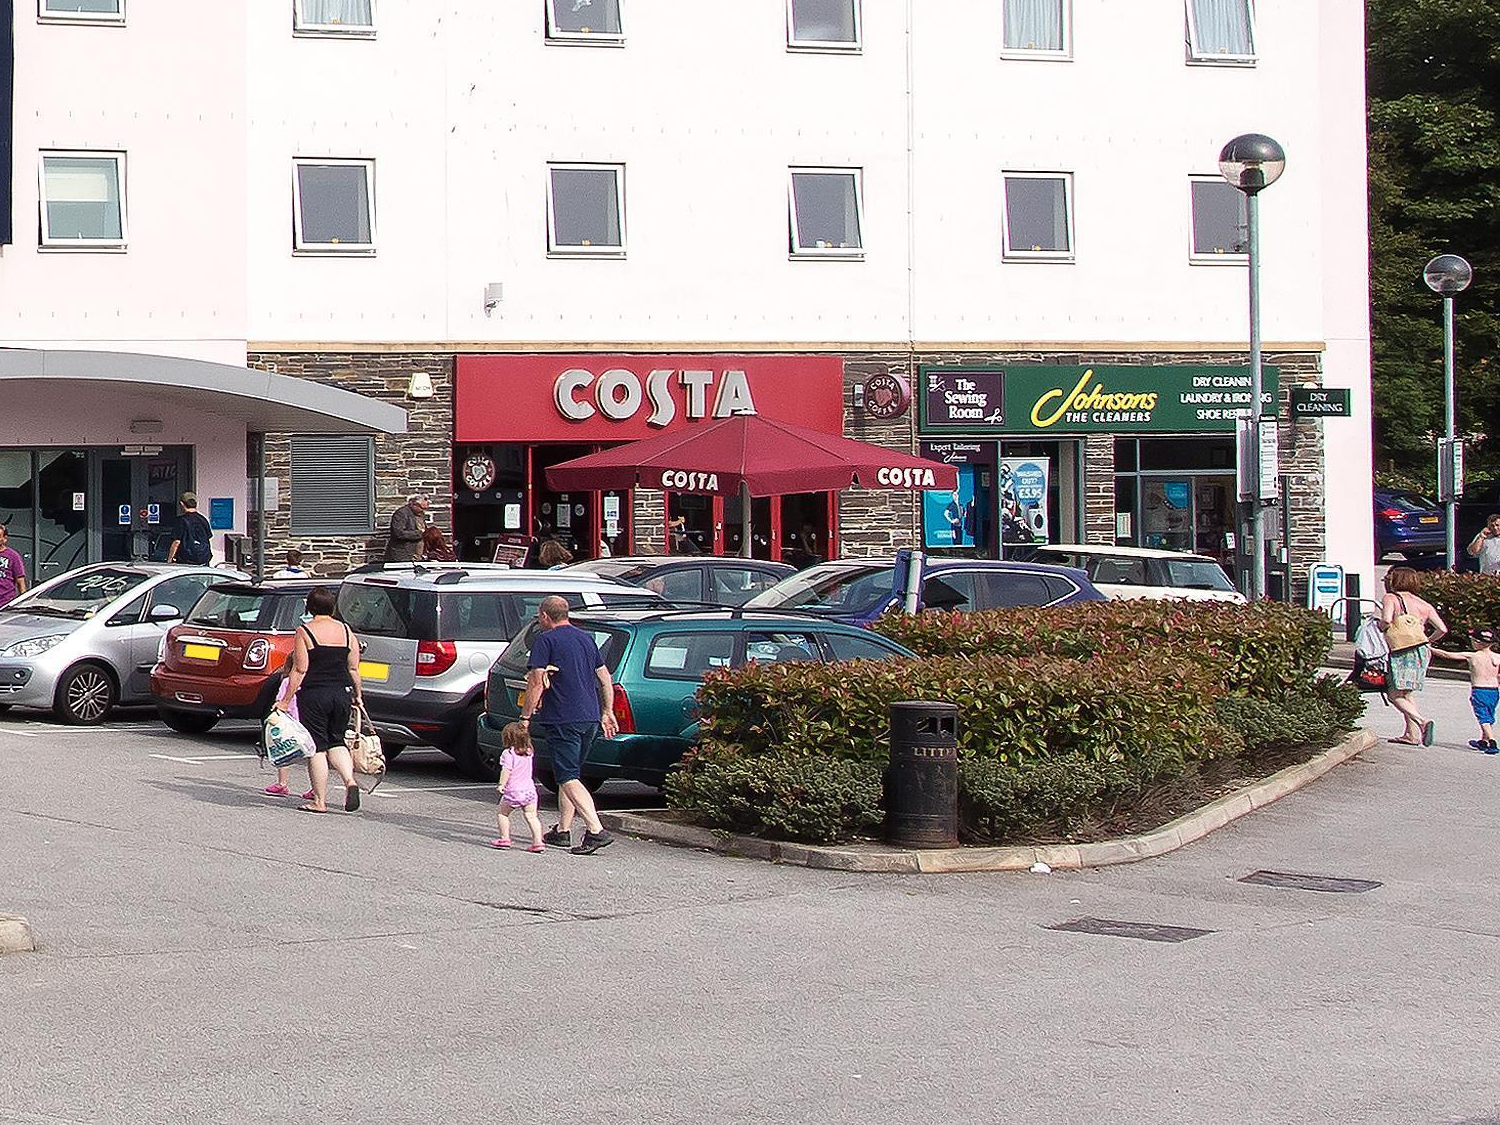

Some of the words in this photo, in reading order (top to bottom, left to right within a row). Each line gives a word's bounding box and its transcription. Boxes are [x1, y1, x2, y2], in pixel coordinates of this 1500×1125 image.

[955, 378, 976, 391] The
[1192, 376, 1211, 387] DRY
[1211, 376, 1252, 387] CLEANIN
[553, 368, 757, 426] COSTA
[944, 390, 988, 407] Sewing
[1030, 368, 1158, 428] Johnsons
[1180, 393, 1223, 403] LAUNDRY
[1223, 393, 1232, 403] &
[1309, 392, 1328, 402] DRY
[948, 405, 984, 419] Room
[1296, 403, 1344, 412] CLEANING
[1065, 412, 1088, 423] THE
[1092, 411, 1151, 422] CLEANERS
[1196, 409, 1222, 420] SHOE
[661, 470, 719, 491] COSTA
[877, 467, 936, 488] COSTA
